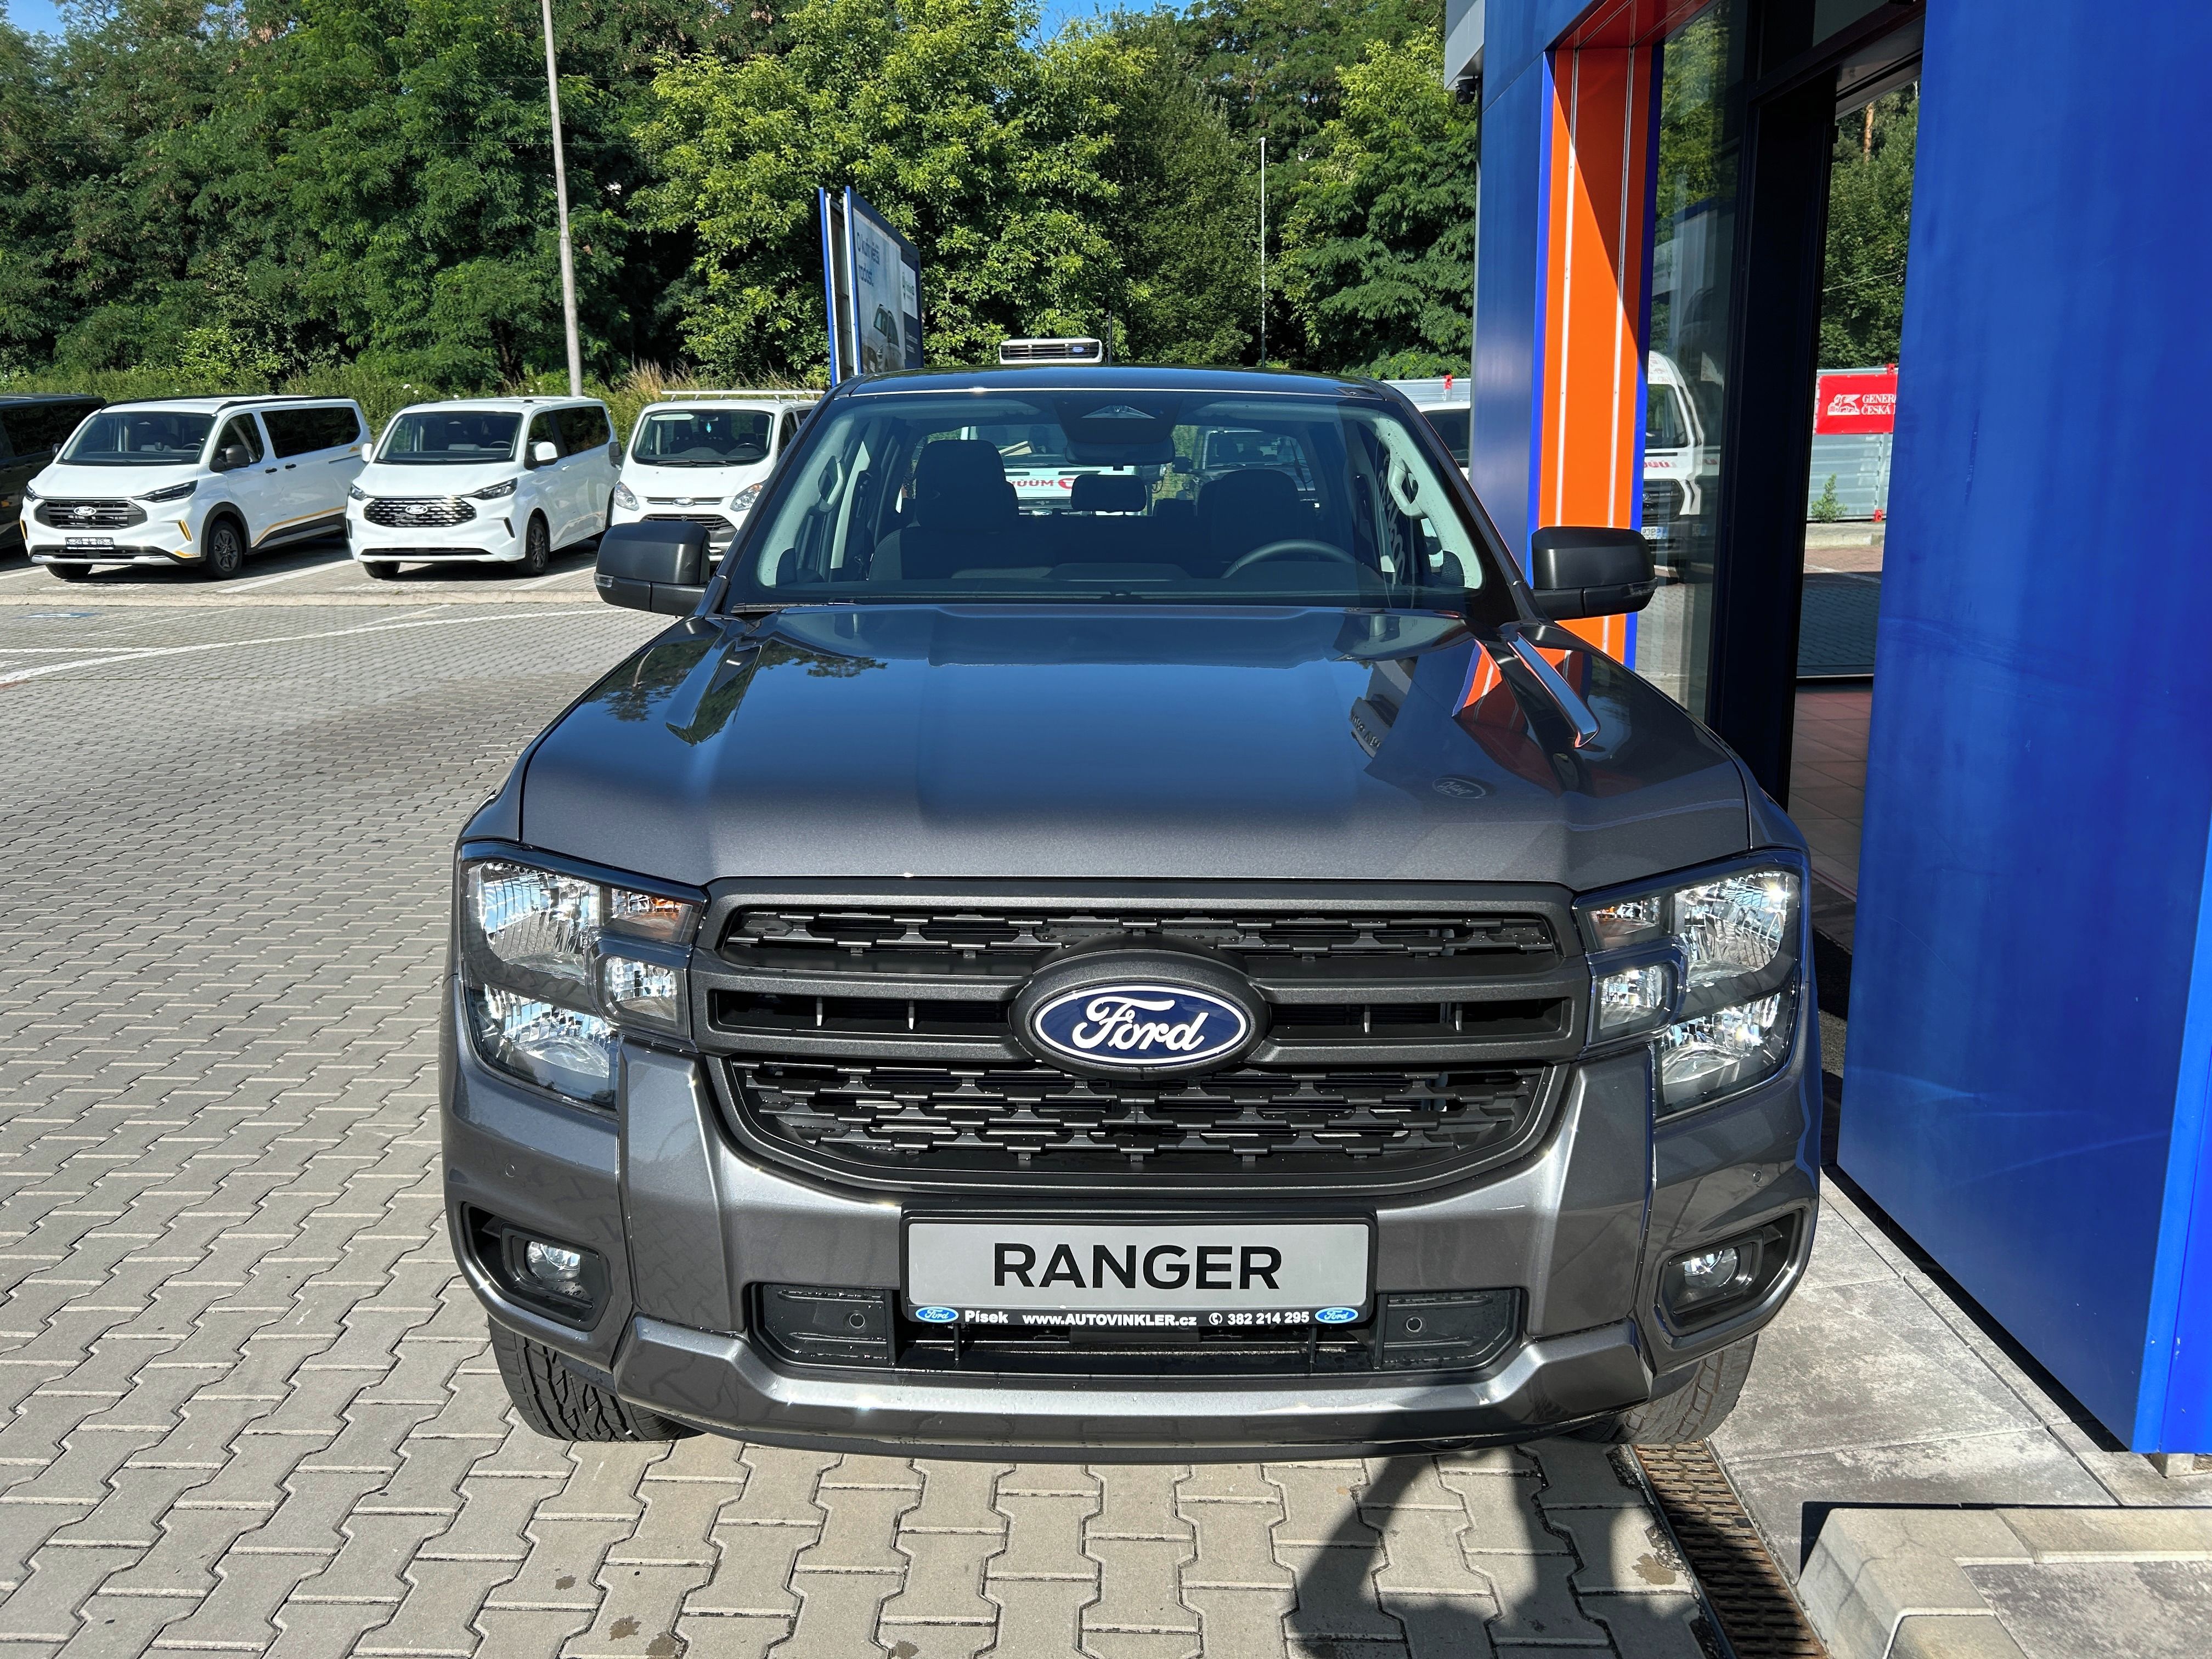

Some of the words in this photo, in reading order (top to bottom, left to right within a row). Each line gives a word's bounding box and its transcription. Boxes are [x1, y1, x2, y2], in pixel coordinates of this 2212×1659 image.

[1861, 403, 1891, 415] ČESKÁ
[1072, 996, 1209, 1051] Ford
[994, 1243, 1282, 1289] RANGER
[924, 1308, 950, 1319] Ford
[964, 1310, 1009, 1323] Písek
[1022, 1313, 1197, 1326] www.AUTOVINKLER.cz
[1227, 1313, 1252, 1325] 382
[1256, 1312, 1282, 1324] 214
[1284, 1311, 1310, 1323] 295
[1324, 1310, 1348, 1320] Ford
